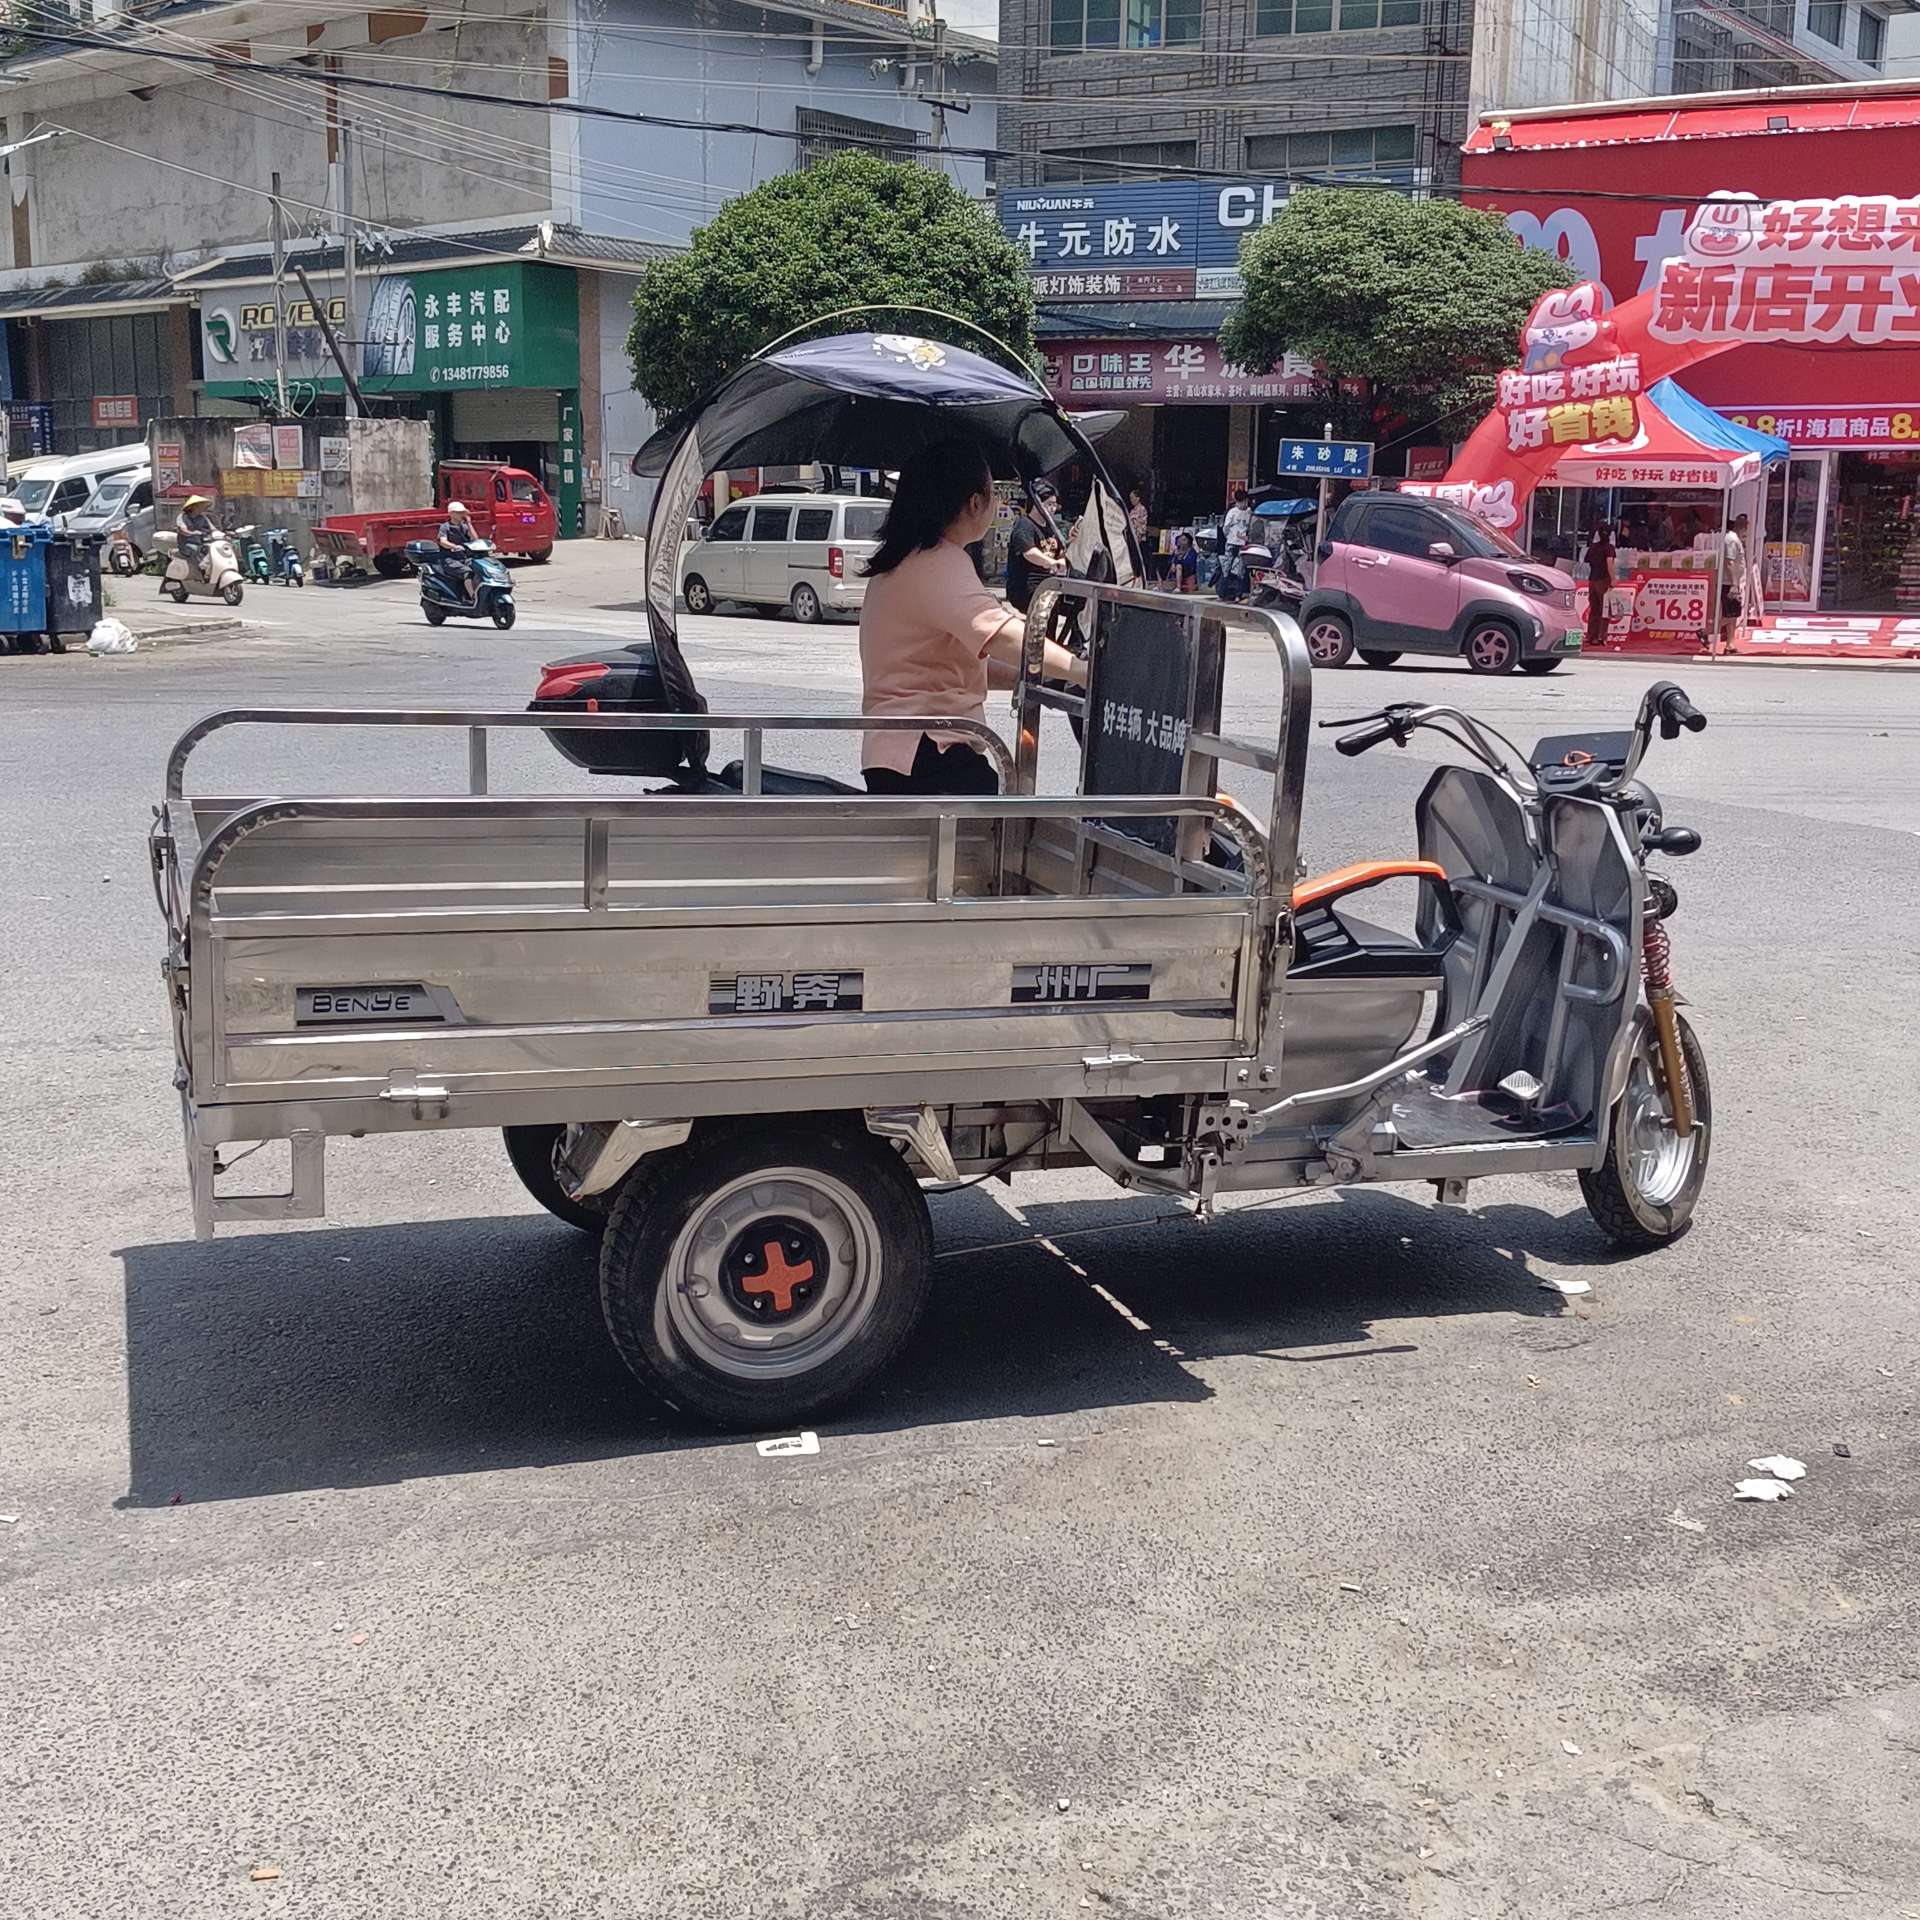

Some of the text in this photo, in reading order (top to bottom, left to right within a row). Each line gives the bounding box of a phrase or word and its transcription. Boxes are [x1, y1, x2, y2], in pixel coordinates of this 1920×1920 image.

[1016, 216, 1182, 259] 牛元防水
[424, 288, 511, 320] 永丰汽配
[424, 320, 511, 350] 服务中心
[442, 364, 510, 381] 13481779856
[1072, 352, 1152, 374] 口味王
[1072, 376, 1152, 391] 全国销量领先
[1500, 359, 1639, 408] 好吃 好玩
[1507, 395, 1635, 452] 好省钱
[1291, 445, 1359, 464] 朱砂路
[1596, 468, 1718, 483] 好吃 好玩 好省钱
[1656, 599, 1704, 620] 16.8
[1103, 699, 1187, 756] 好车辆 大品牌
[312, 993, 411, 1014] BENYE
